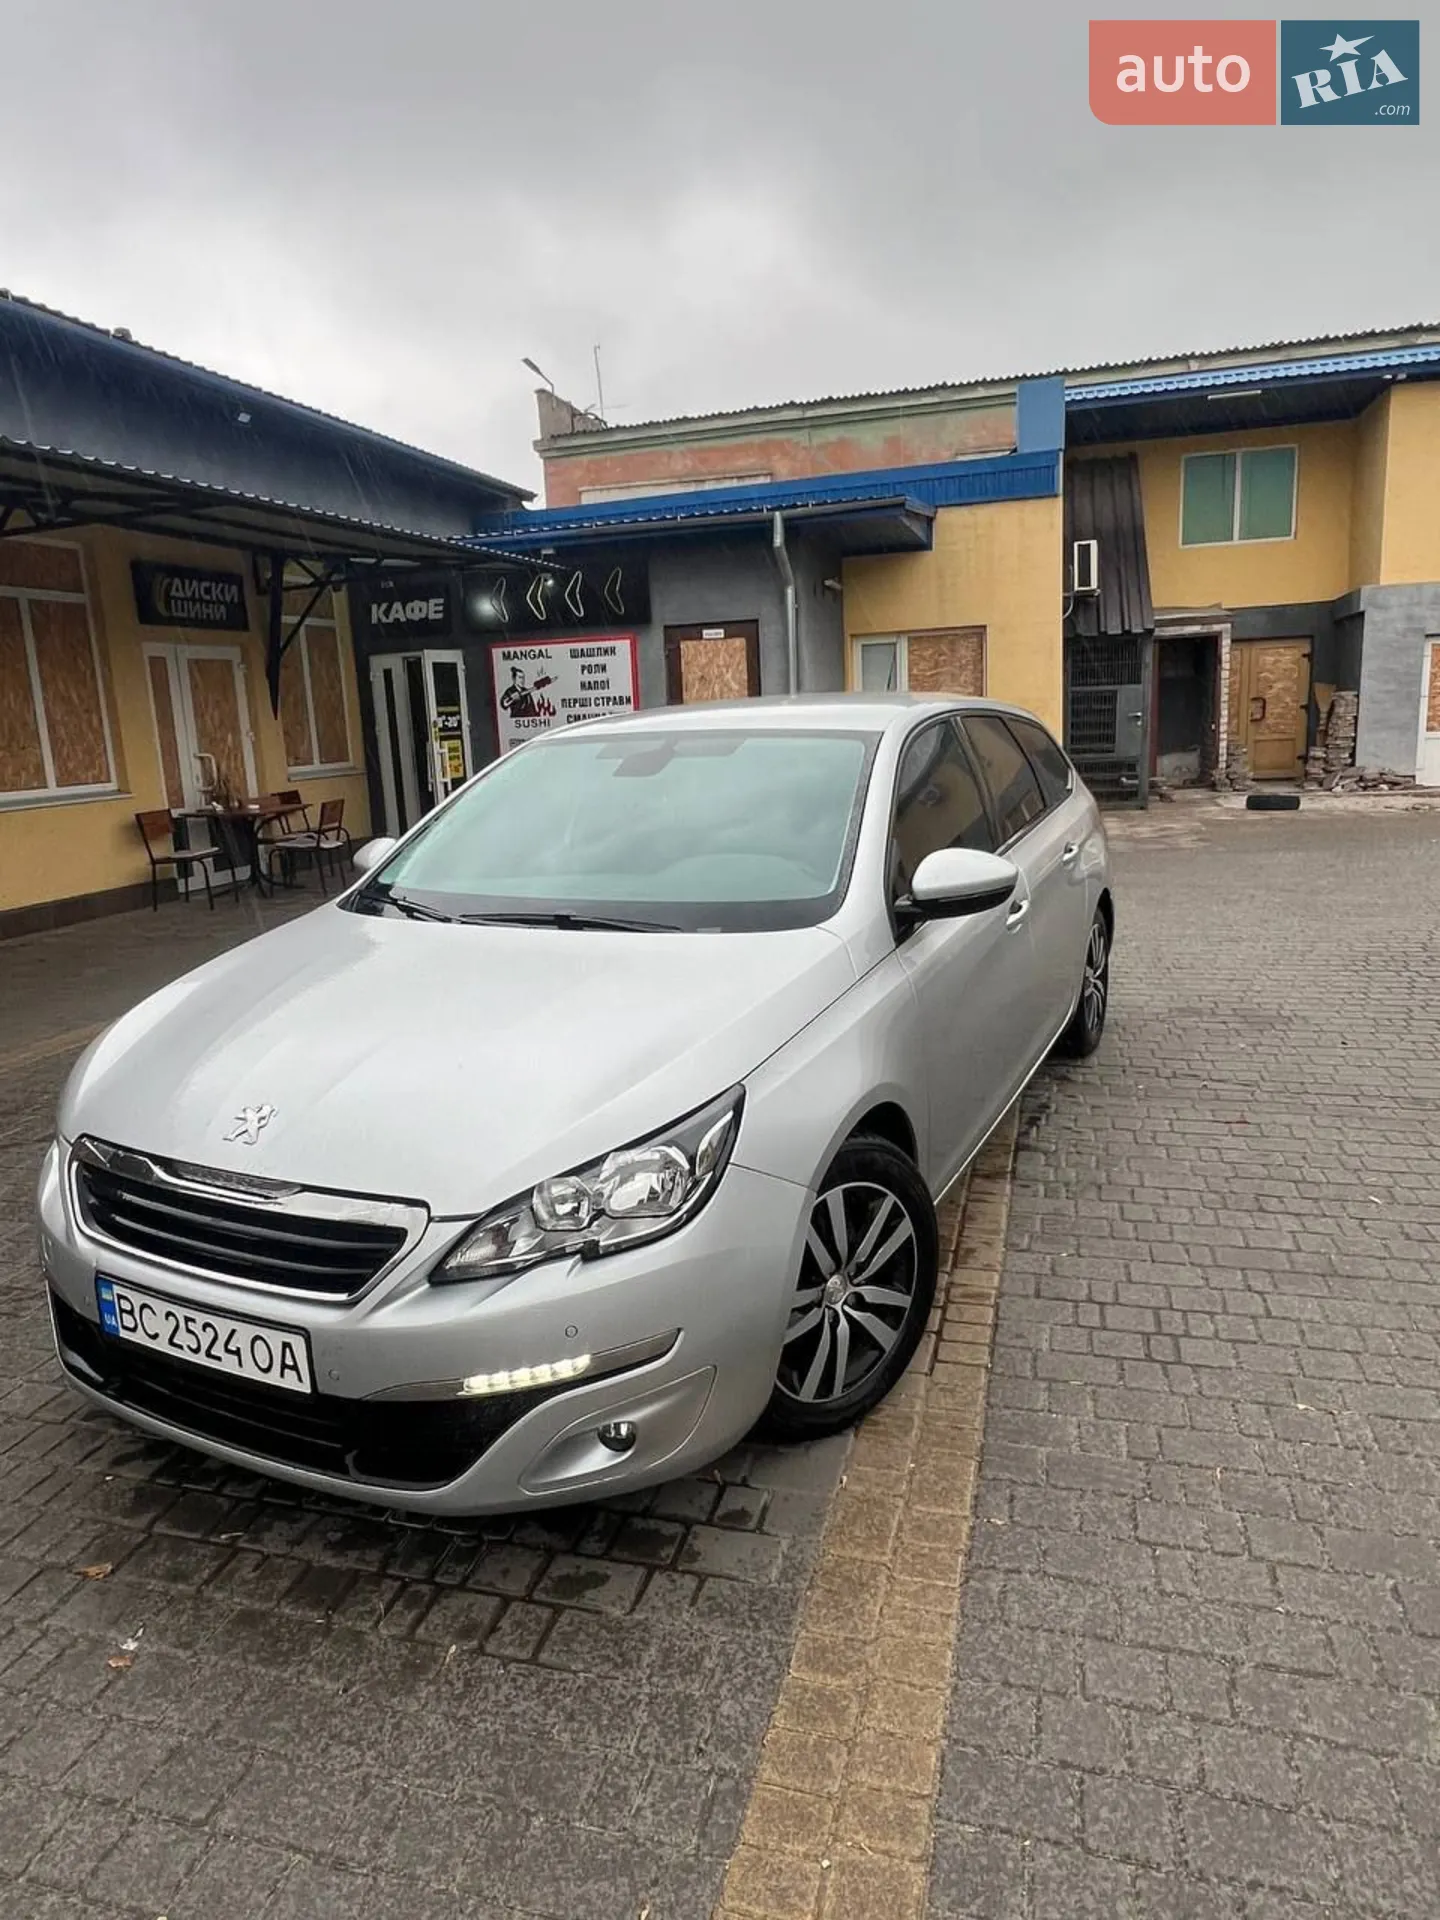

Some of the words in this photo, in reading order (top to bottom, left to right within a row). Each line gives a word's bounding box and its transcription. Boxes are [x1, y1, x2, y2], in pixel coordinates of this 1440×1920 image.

[169, 577, 239, 604] ДИСКИ
[170, 600, 227, 620] ШИНИ
[371, 598, 445, 624] КАФЕ
[502, 648, 552, 660] MANGAL
[569, 646, 616, 659] ШАШЛИК
[580, 663, 607, 675] РОЛИ
[580, 678, 610, 691] НАПОЇ
[560, 697, 591, 708] ПЕРШІ
[594, 695, 632, 707] СТРАВИ
[514, 718, 551, 729] SUSHI
[104, 1313, 118, 1328] UA
